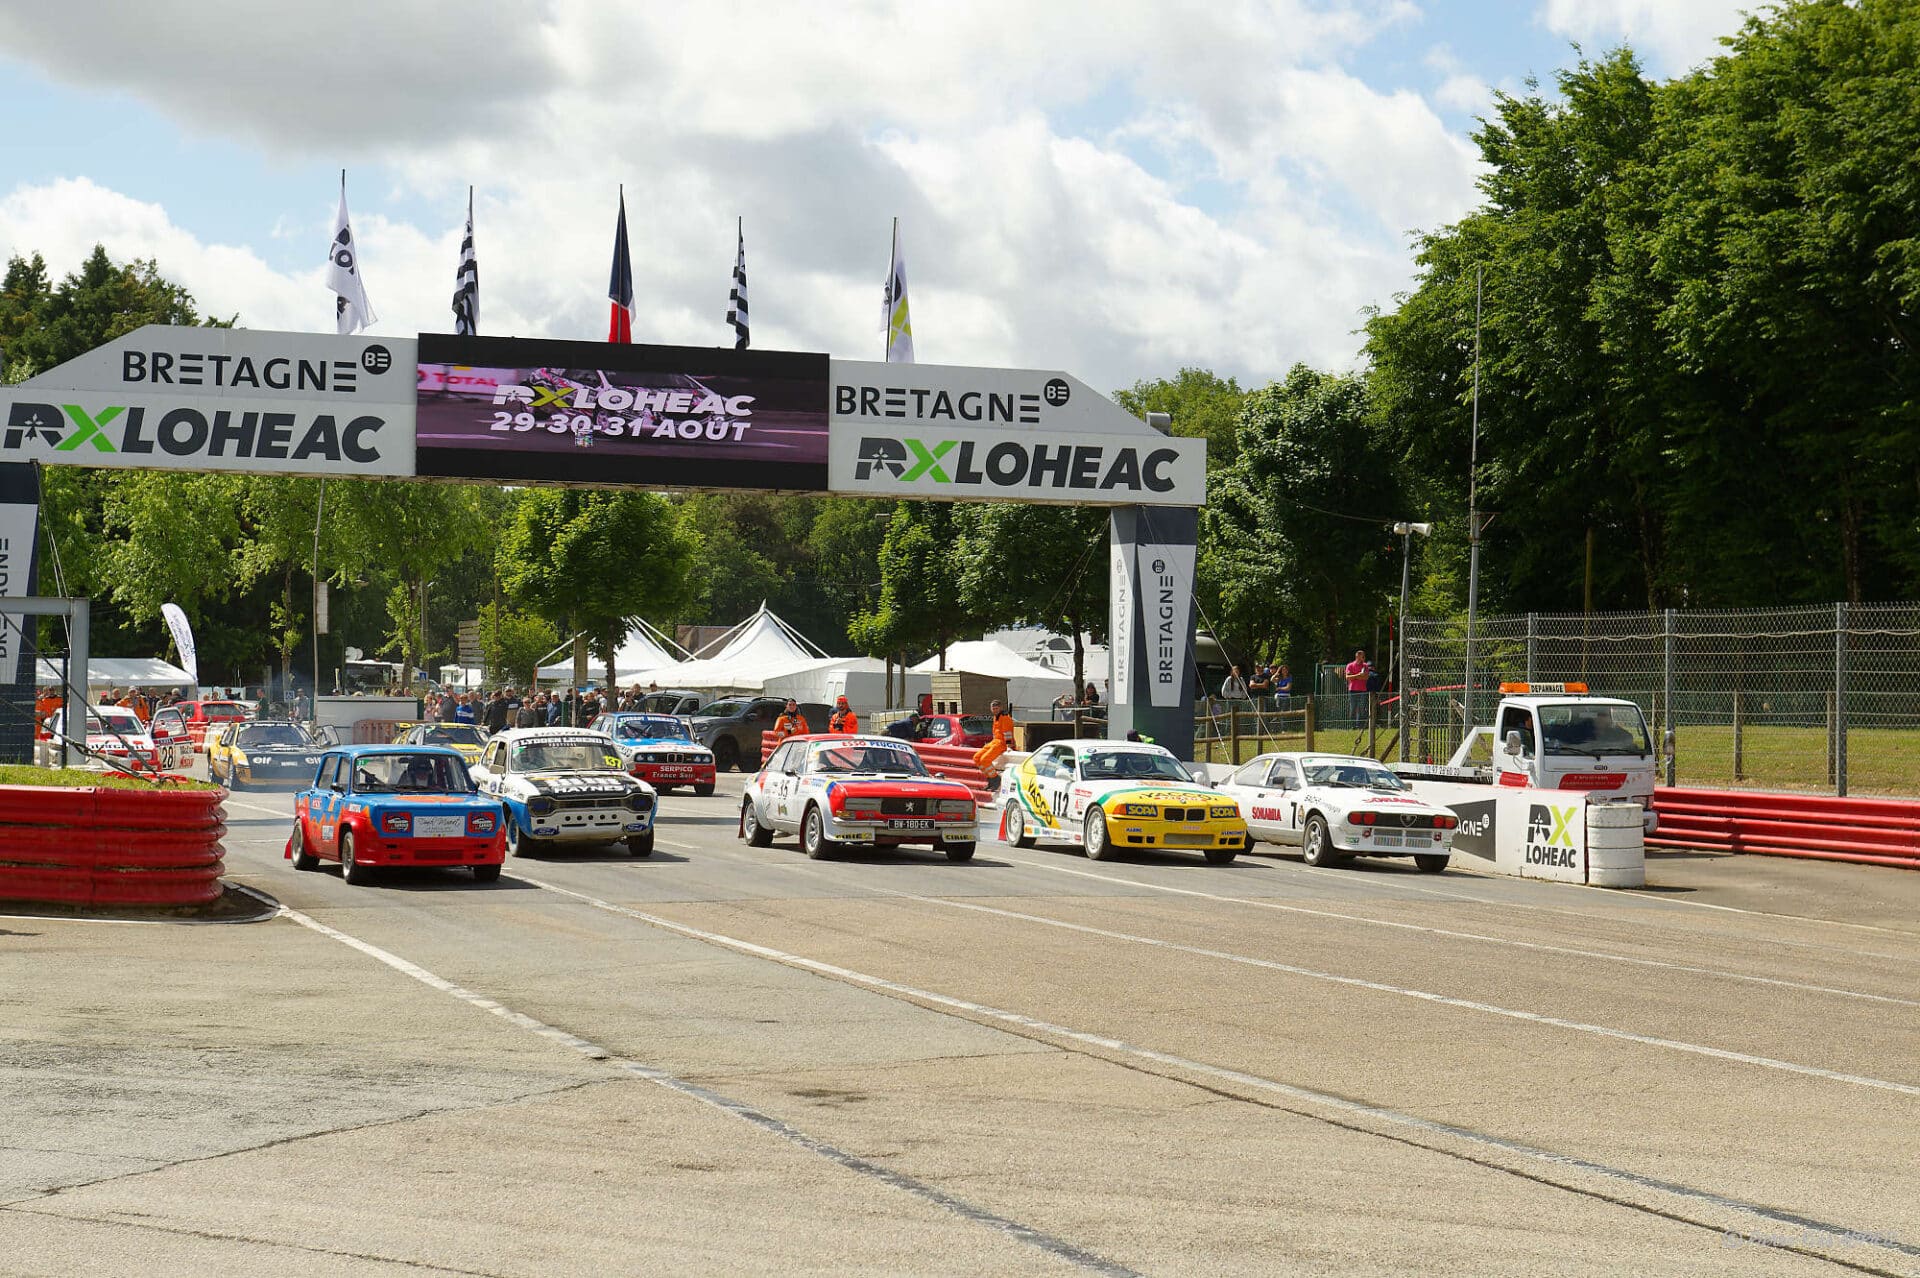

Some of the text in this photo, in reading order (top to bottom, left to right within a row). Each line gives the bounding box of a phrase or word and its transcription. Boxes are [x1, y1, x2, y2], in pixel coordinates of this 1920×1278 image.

[122, 350, 357, 393] BRETAGNE
[836, 385, 1040, 424] BRETAGNE
[490, 411, 752, 442] 29-30-31 AOÛT
[1159, 575, 1174, 684] BRETAGNE
[162, 746, 174, 769] 28
[841, 739, 909, 751] ESSO PEUGEOT
[252, 755, 272, 765] elf
[603, 755, 622, 769] 137
[554, 784, 625, 794] HAYNES
[1028, 777, 1053, 826] YACCO
[1052, 790, 1069, 818] 112
[1526, 803, 1578, 847] RX
[1525, 843, 1577, 869] LOHEAC
